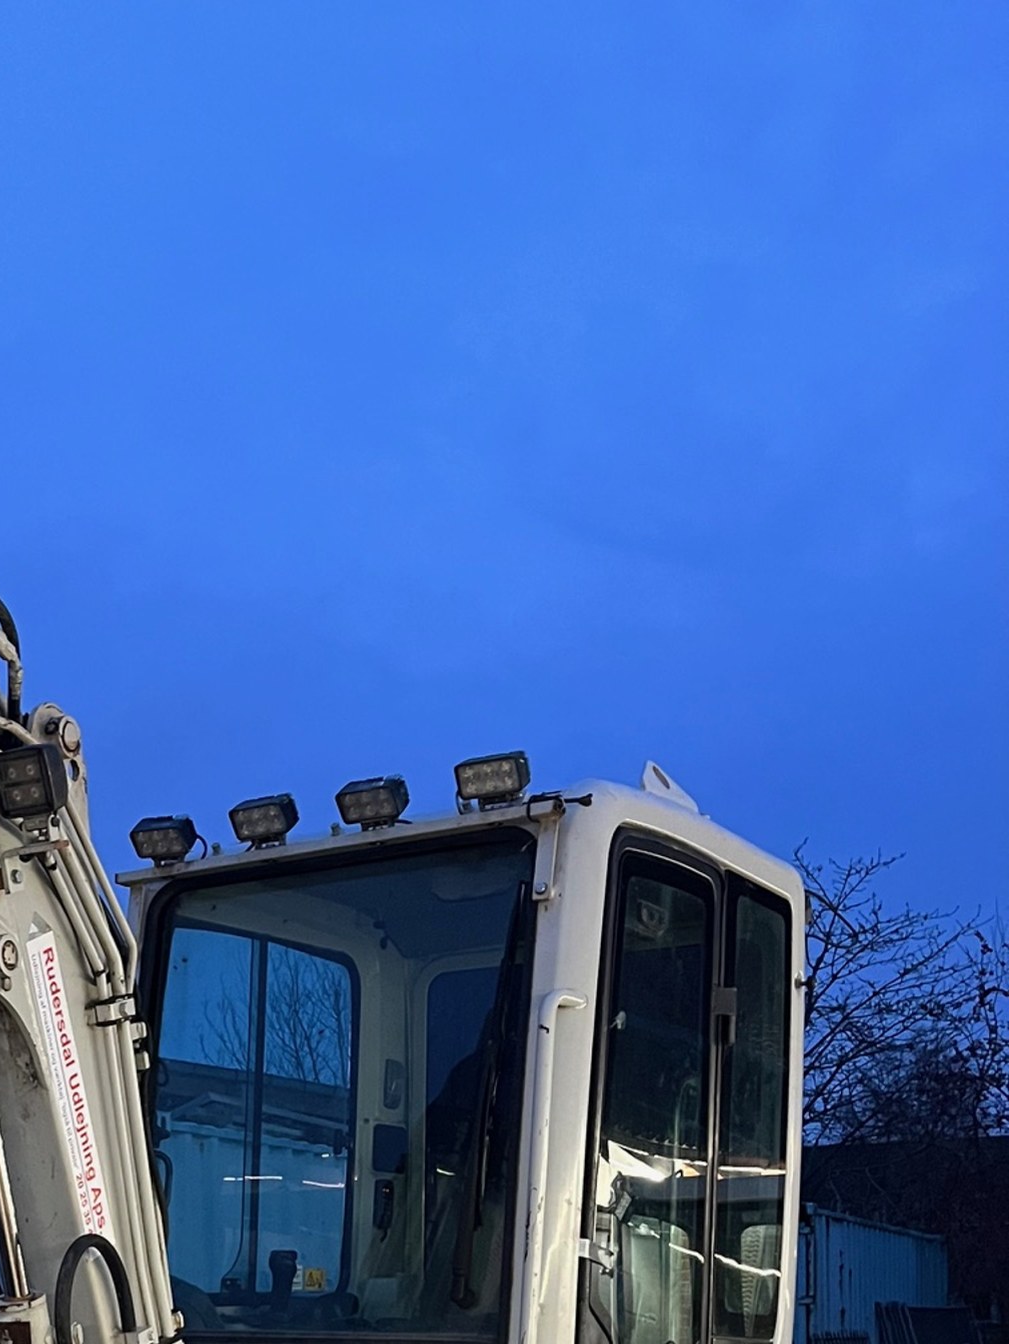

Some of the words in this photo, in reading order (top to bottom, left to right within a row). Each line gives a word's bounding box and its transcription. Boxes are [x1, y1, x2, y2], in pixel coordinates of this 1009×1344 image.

[41, 946, 76, 1067] Rudersdal
[64, 1073, 99, 1181] Udlejning
[75, 1173, 84, 1188] 20
